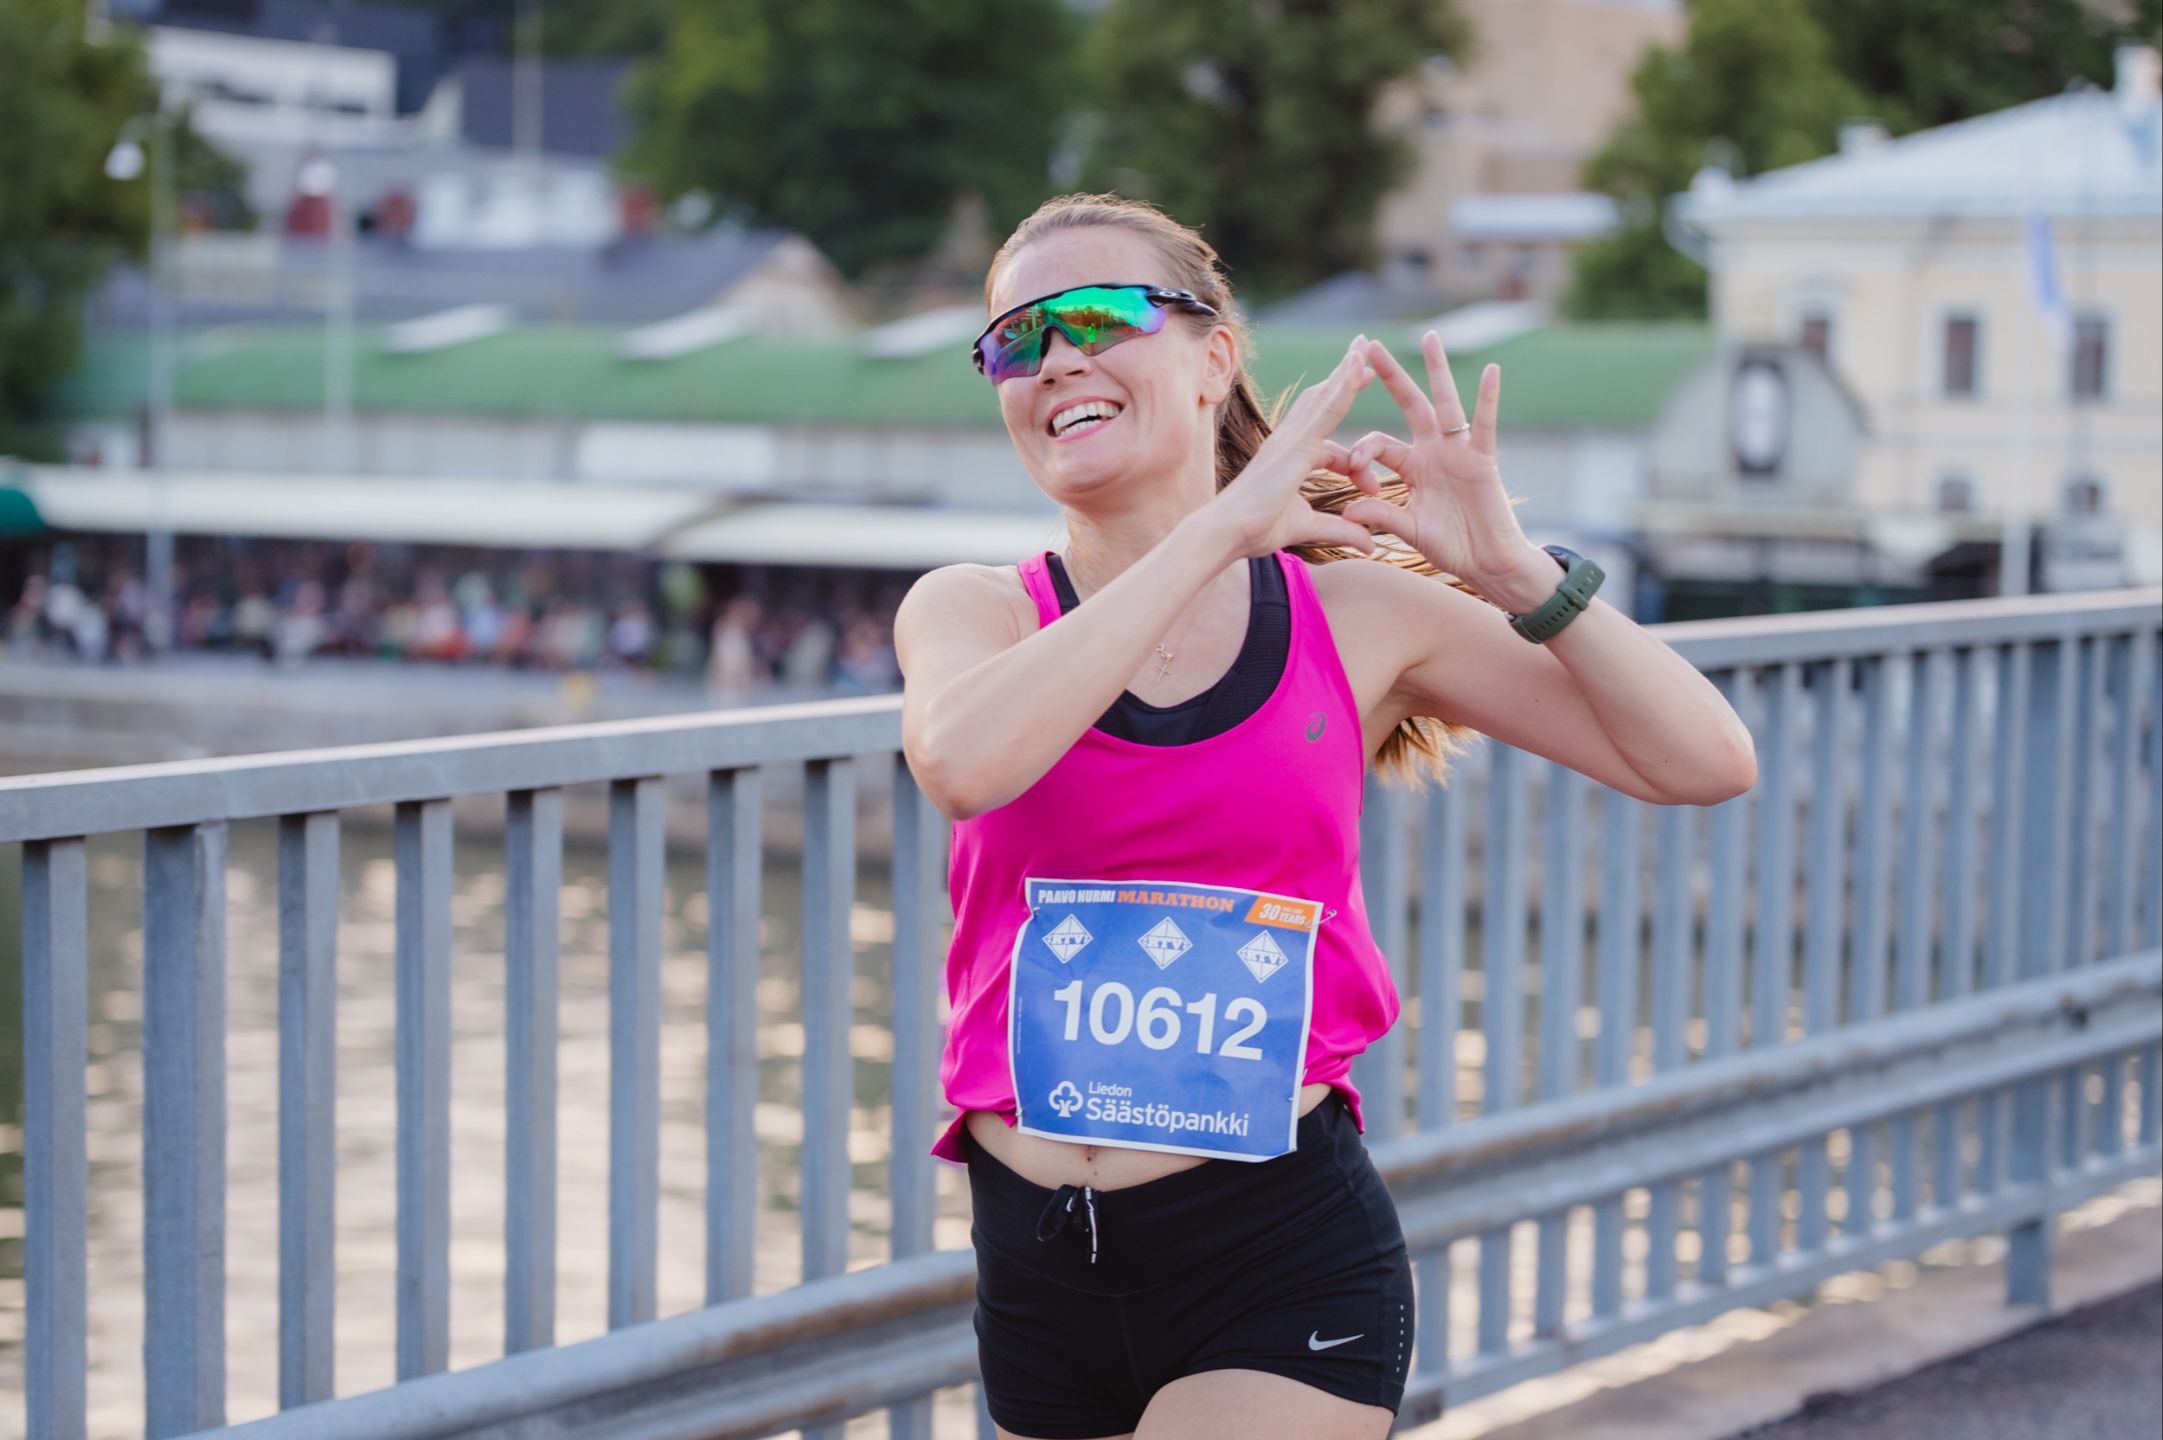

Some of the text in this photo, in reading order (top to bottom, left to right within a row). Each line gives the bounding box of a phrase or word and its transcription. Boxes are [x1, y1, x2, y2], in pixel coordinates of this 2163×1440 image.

[1038, 890, 1076, 904] PAAVO
[1117, 890, 1235, 912] MARATHON
[1259, 902, 1281, 920] 30
[1053, 980, 1268, 1061] 10612
[1088, 1081, 1132, 1098] Liedon
[1085, 1097, 1249, 1137] Säästöpankki
